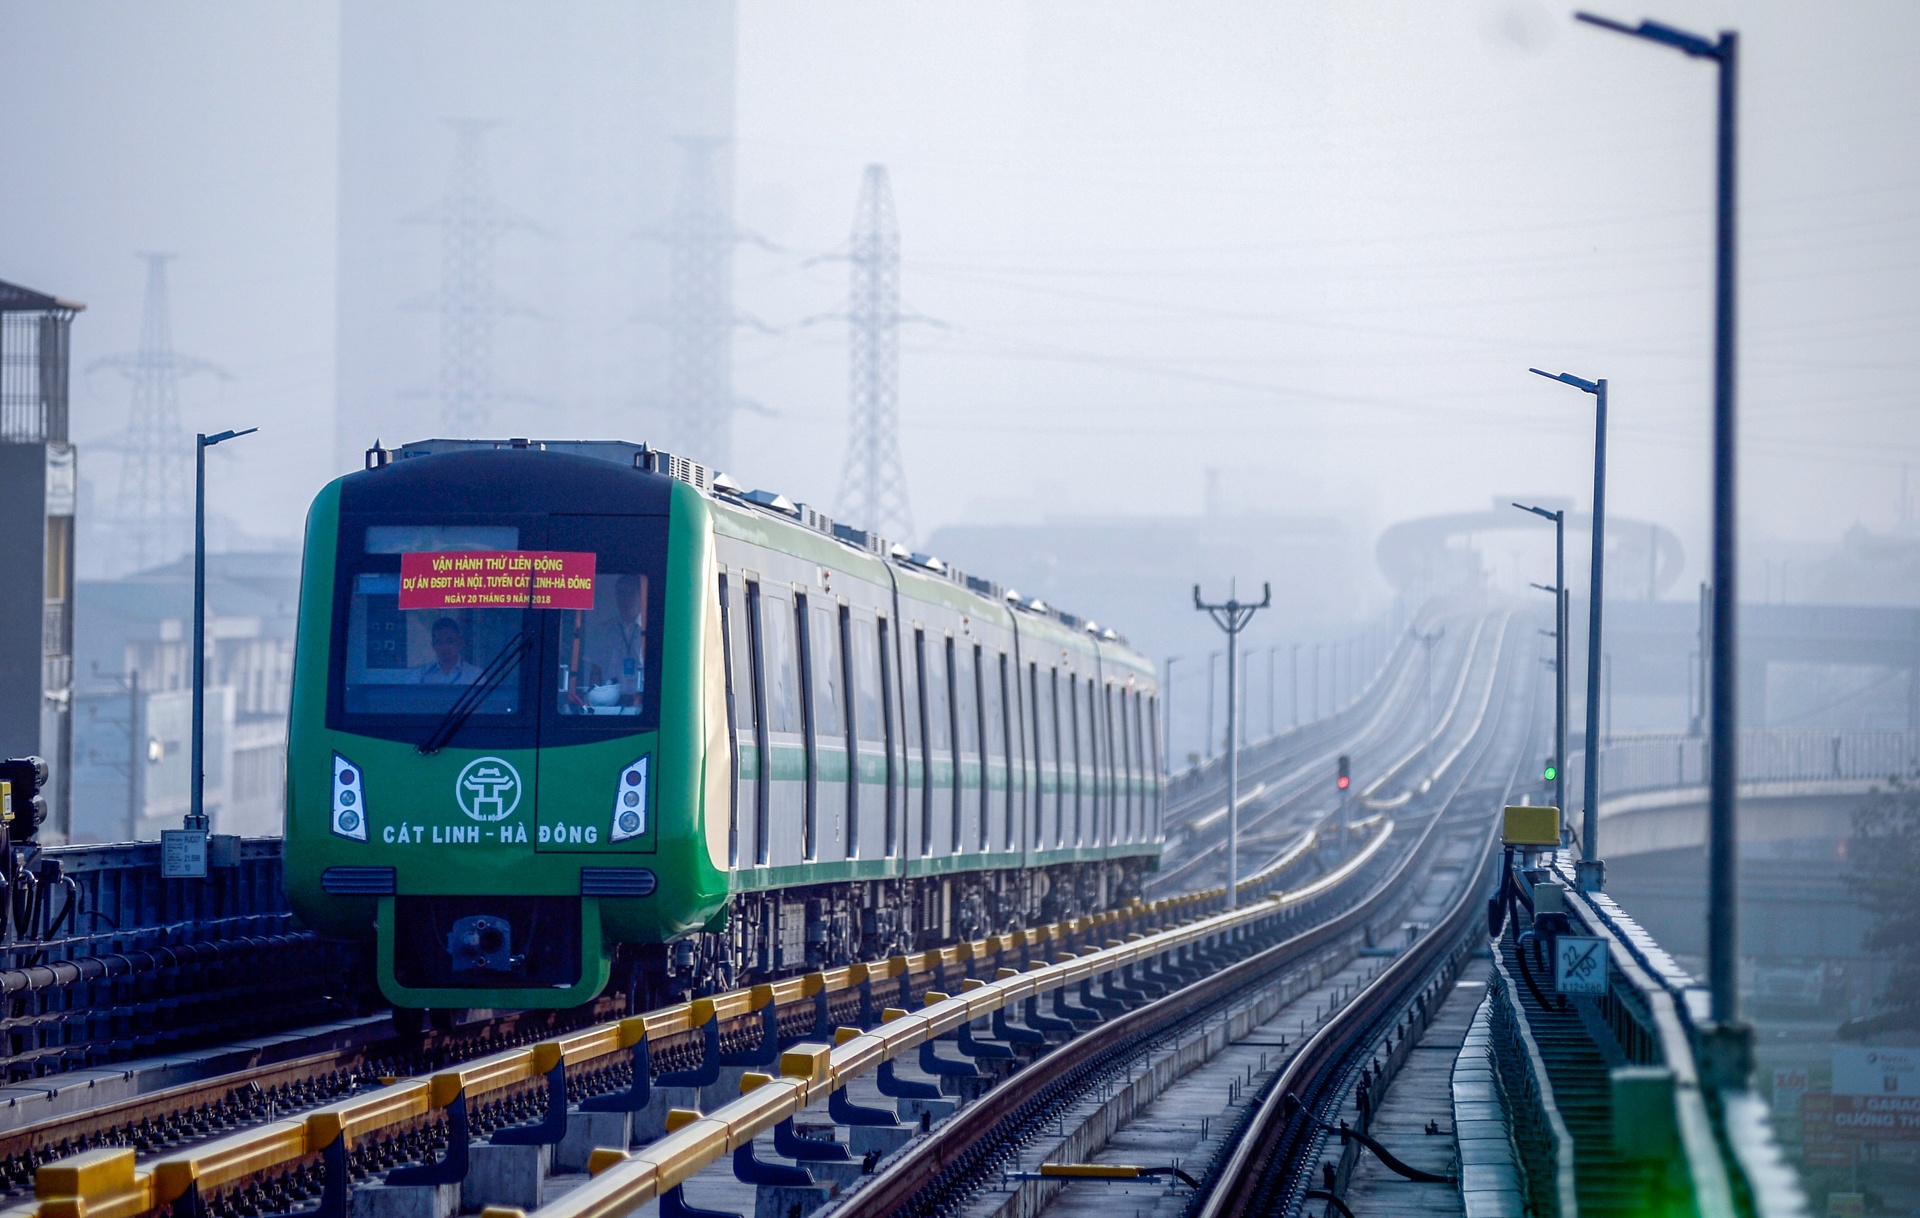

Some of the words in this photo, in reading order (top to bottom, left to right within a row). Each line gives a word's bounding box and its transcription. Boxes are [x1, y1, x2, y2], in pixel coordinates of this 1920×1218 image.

[432, 556, 452, 573] VẬN
[455, 555, 483, 570] HÀNH
[486, 555, 508, 570] THỬ
[509, 555, 531, 570] LIÊN
[534, 555, 563, 573] ĐỘNG
[403, 576, 415, 592] DỰ
[417, 574, 428, 589] ÁN
[454, 573, 465, 588] HÀ
[514, 573, 531, 588] CÁT
[567, 574, 592, 590] ĐÔNG
[444, 592, 466, 604] NGÀY
[467, 594, 478, 603] 20
[479, 592, 505, 603] THÁNG
[506, 594, 512, 603] 9
[532, 595, 551, 604] 2018
[383, 822, 424, 843] CÁT
[432, 826, 479, 843] LINH
[500, 822, 528, 843] HÀ
[538, 822, 598, 843] ĐÔNG
[1562, 945, 1581, 966] 22
[1576, 957, 1596, 982] 150
